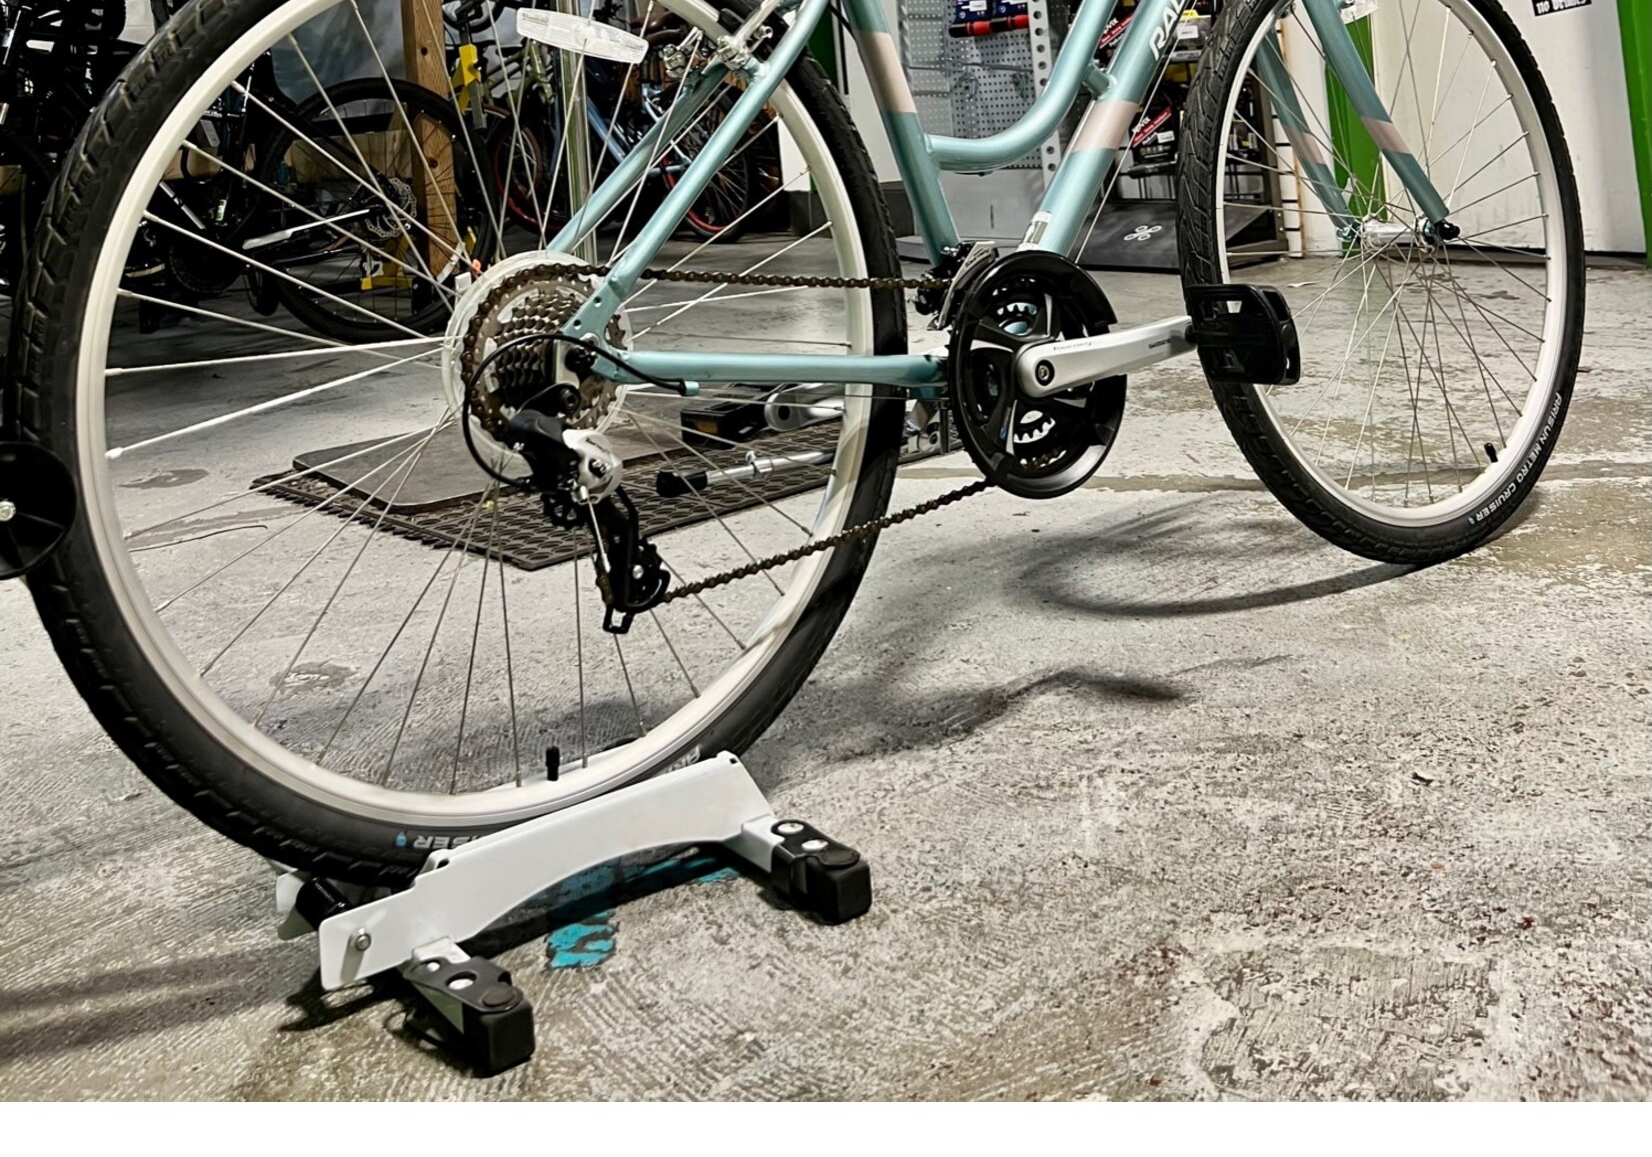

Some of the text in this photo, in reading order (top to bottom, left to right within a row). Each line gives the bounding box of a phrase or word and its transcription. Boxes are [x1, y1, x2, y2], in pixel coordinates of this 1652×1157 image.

[1536, 1, 1551, 14] no
[1516, 445, 1543, 484] METRO
[1475, 482, 1517, 523] CRUISER
